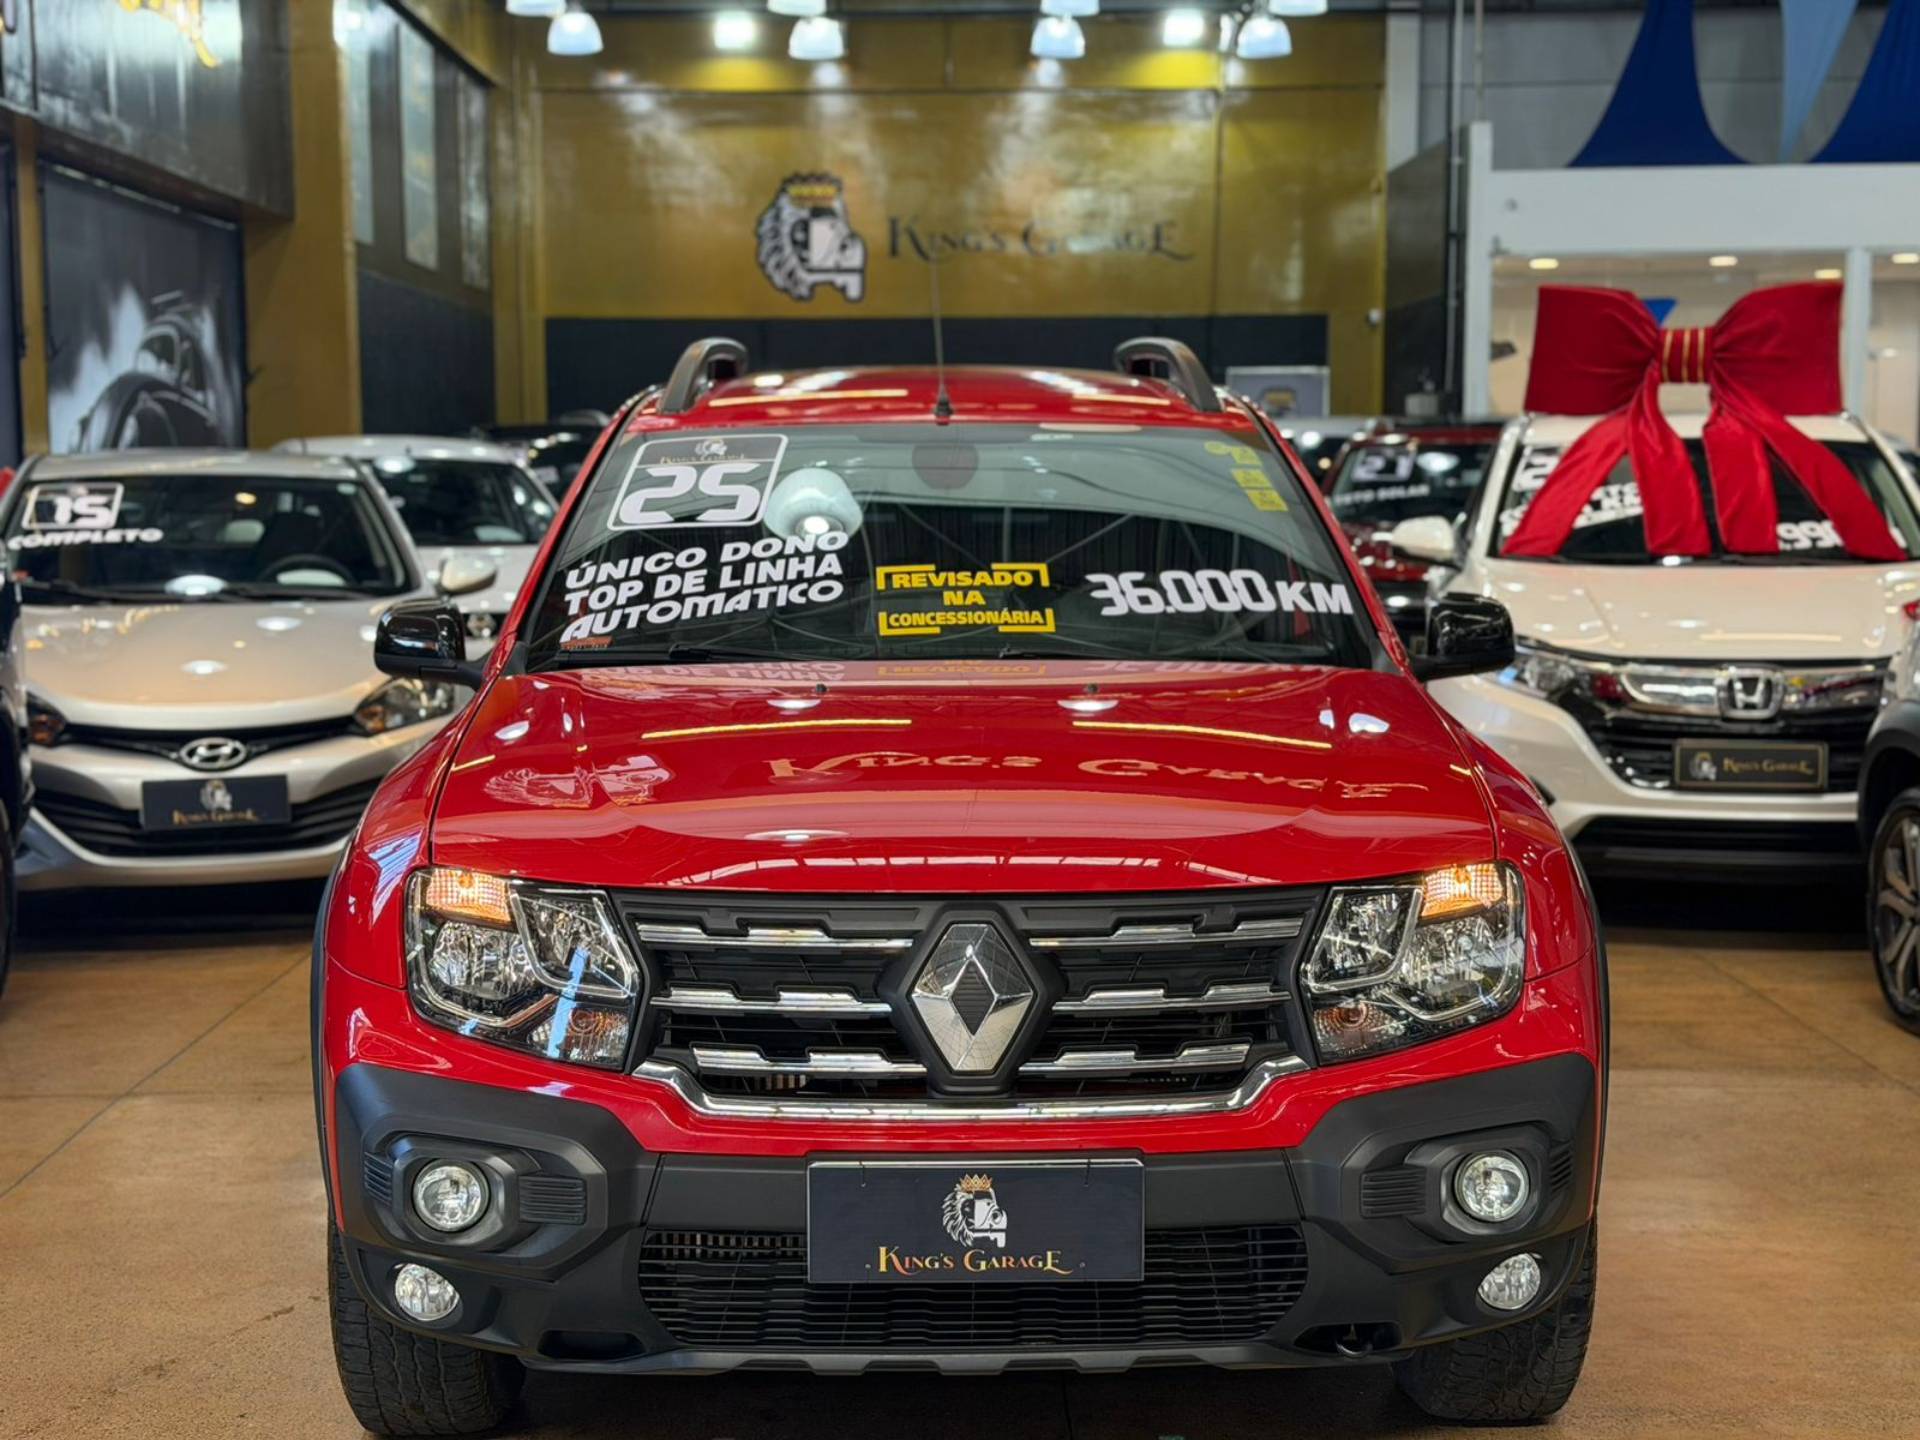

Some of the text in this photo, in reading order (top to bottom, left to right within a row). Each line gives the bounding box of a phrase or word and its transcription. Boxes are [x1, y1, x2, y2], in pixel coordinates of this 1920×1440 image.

[619, 462, 760, 525] 25
[8, 528, 163, 550] COMPLETO
[565, 531, 849, 588] ÚNICO DONO
[564, 553, 843, 615] TOP DE LINHA
[892, 571, 1033, 588] REVISADO
[1085, 569, 1354, 616] 36.000 KM
[943, 590, 986, 606] NA
[889, 607, 1044, 627] CONCESSIONÁRIA
[879, 1246, 1074, 1276] KING'S GARAGE
